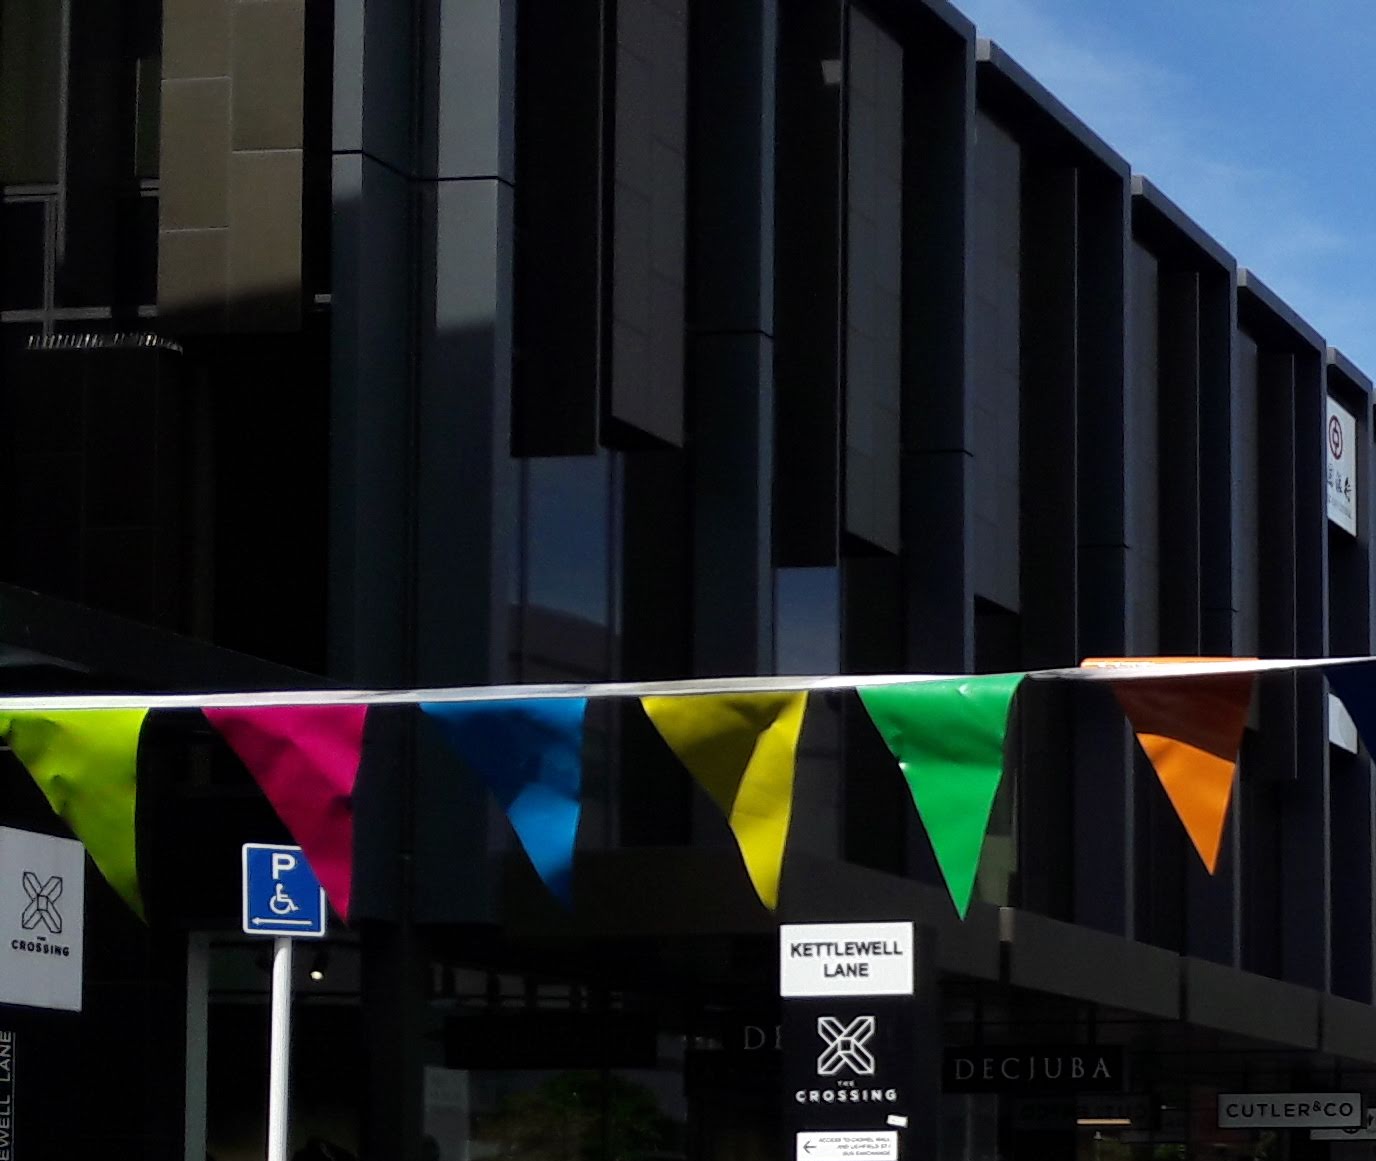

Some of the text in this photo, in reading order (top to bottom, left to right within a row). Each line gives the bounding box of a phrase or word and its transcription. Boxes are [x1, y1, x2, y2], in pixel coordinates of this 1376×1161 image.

[272, 852, 296, 880] P
[11, 939, 70, 957] CROSSING
[789, 940, 903, 958] KETTLEWELL
[823, 962, 869, 978] LANE
[954, 1056, 1112, 1080] DECJUBA
[795, 1088, 897, 1103] CROSSING
[1226, 1100, 1354, 1118] CUTLER&CO
